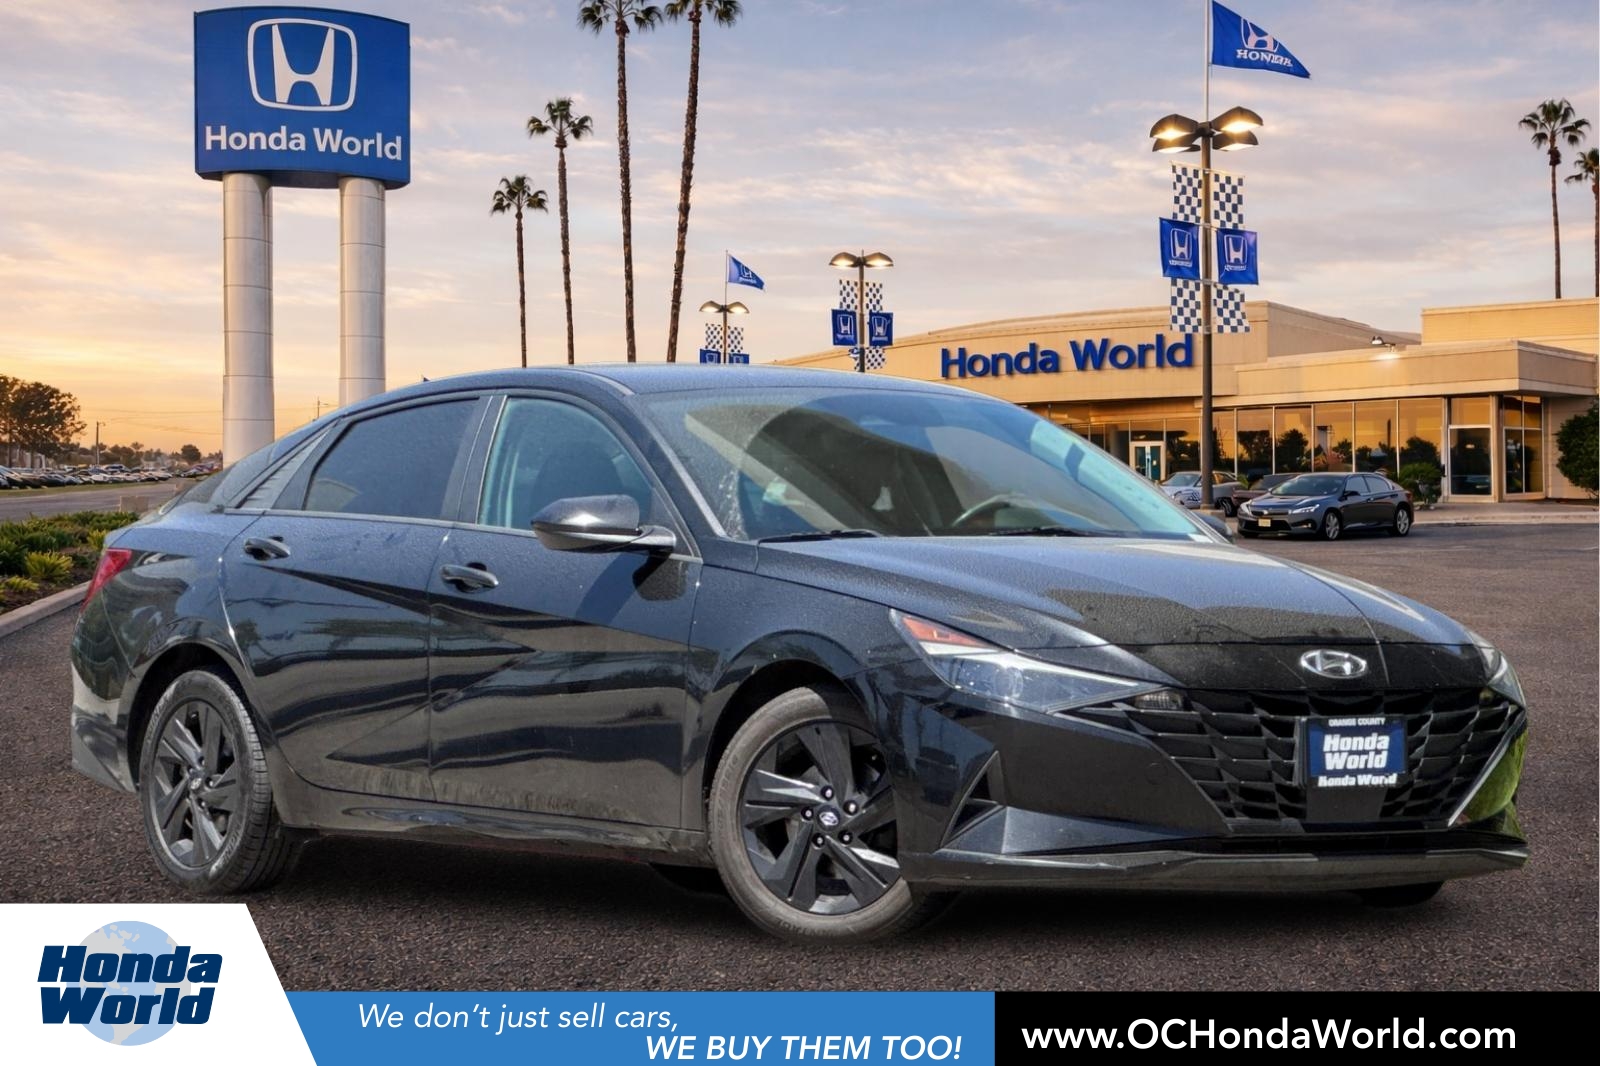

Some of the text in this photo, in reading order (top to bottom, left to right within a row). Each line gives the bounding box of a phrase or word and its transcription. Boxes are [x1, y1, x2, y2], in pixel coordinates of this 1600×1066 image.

[205, 126, 402, 160] Honda World
[941, 333, 1194, 378] Honda World
[1323, 732, 1390, 752] Honda
[1325, 750, 1388, 770] World
